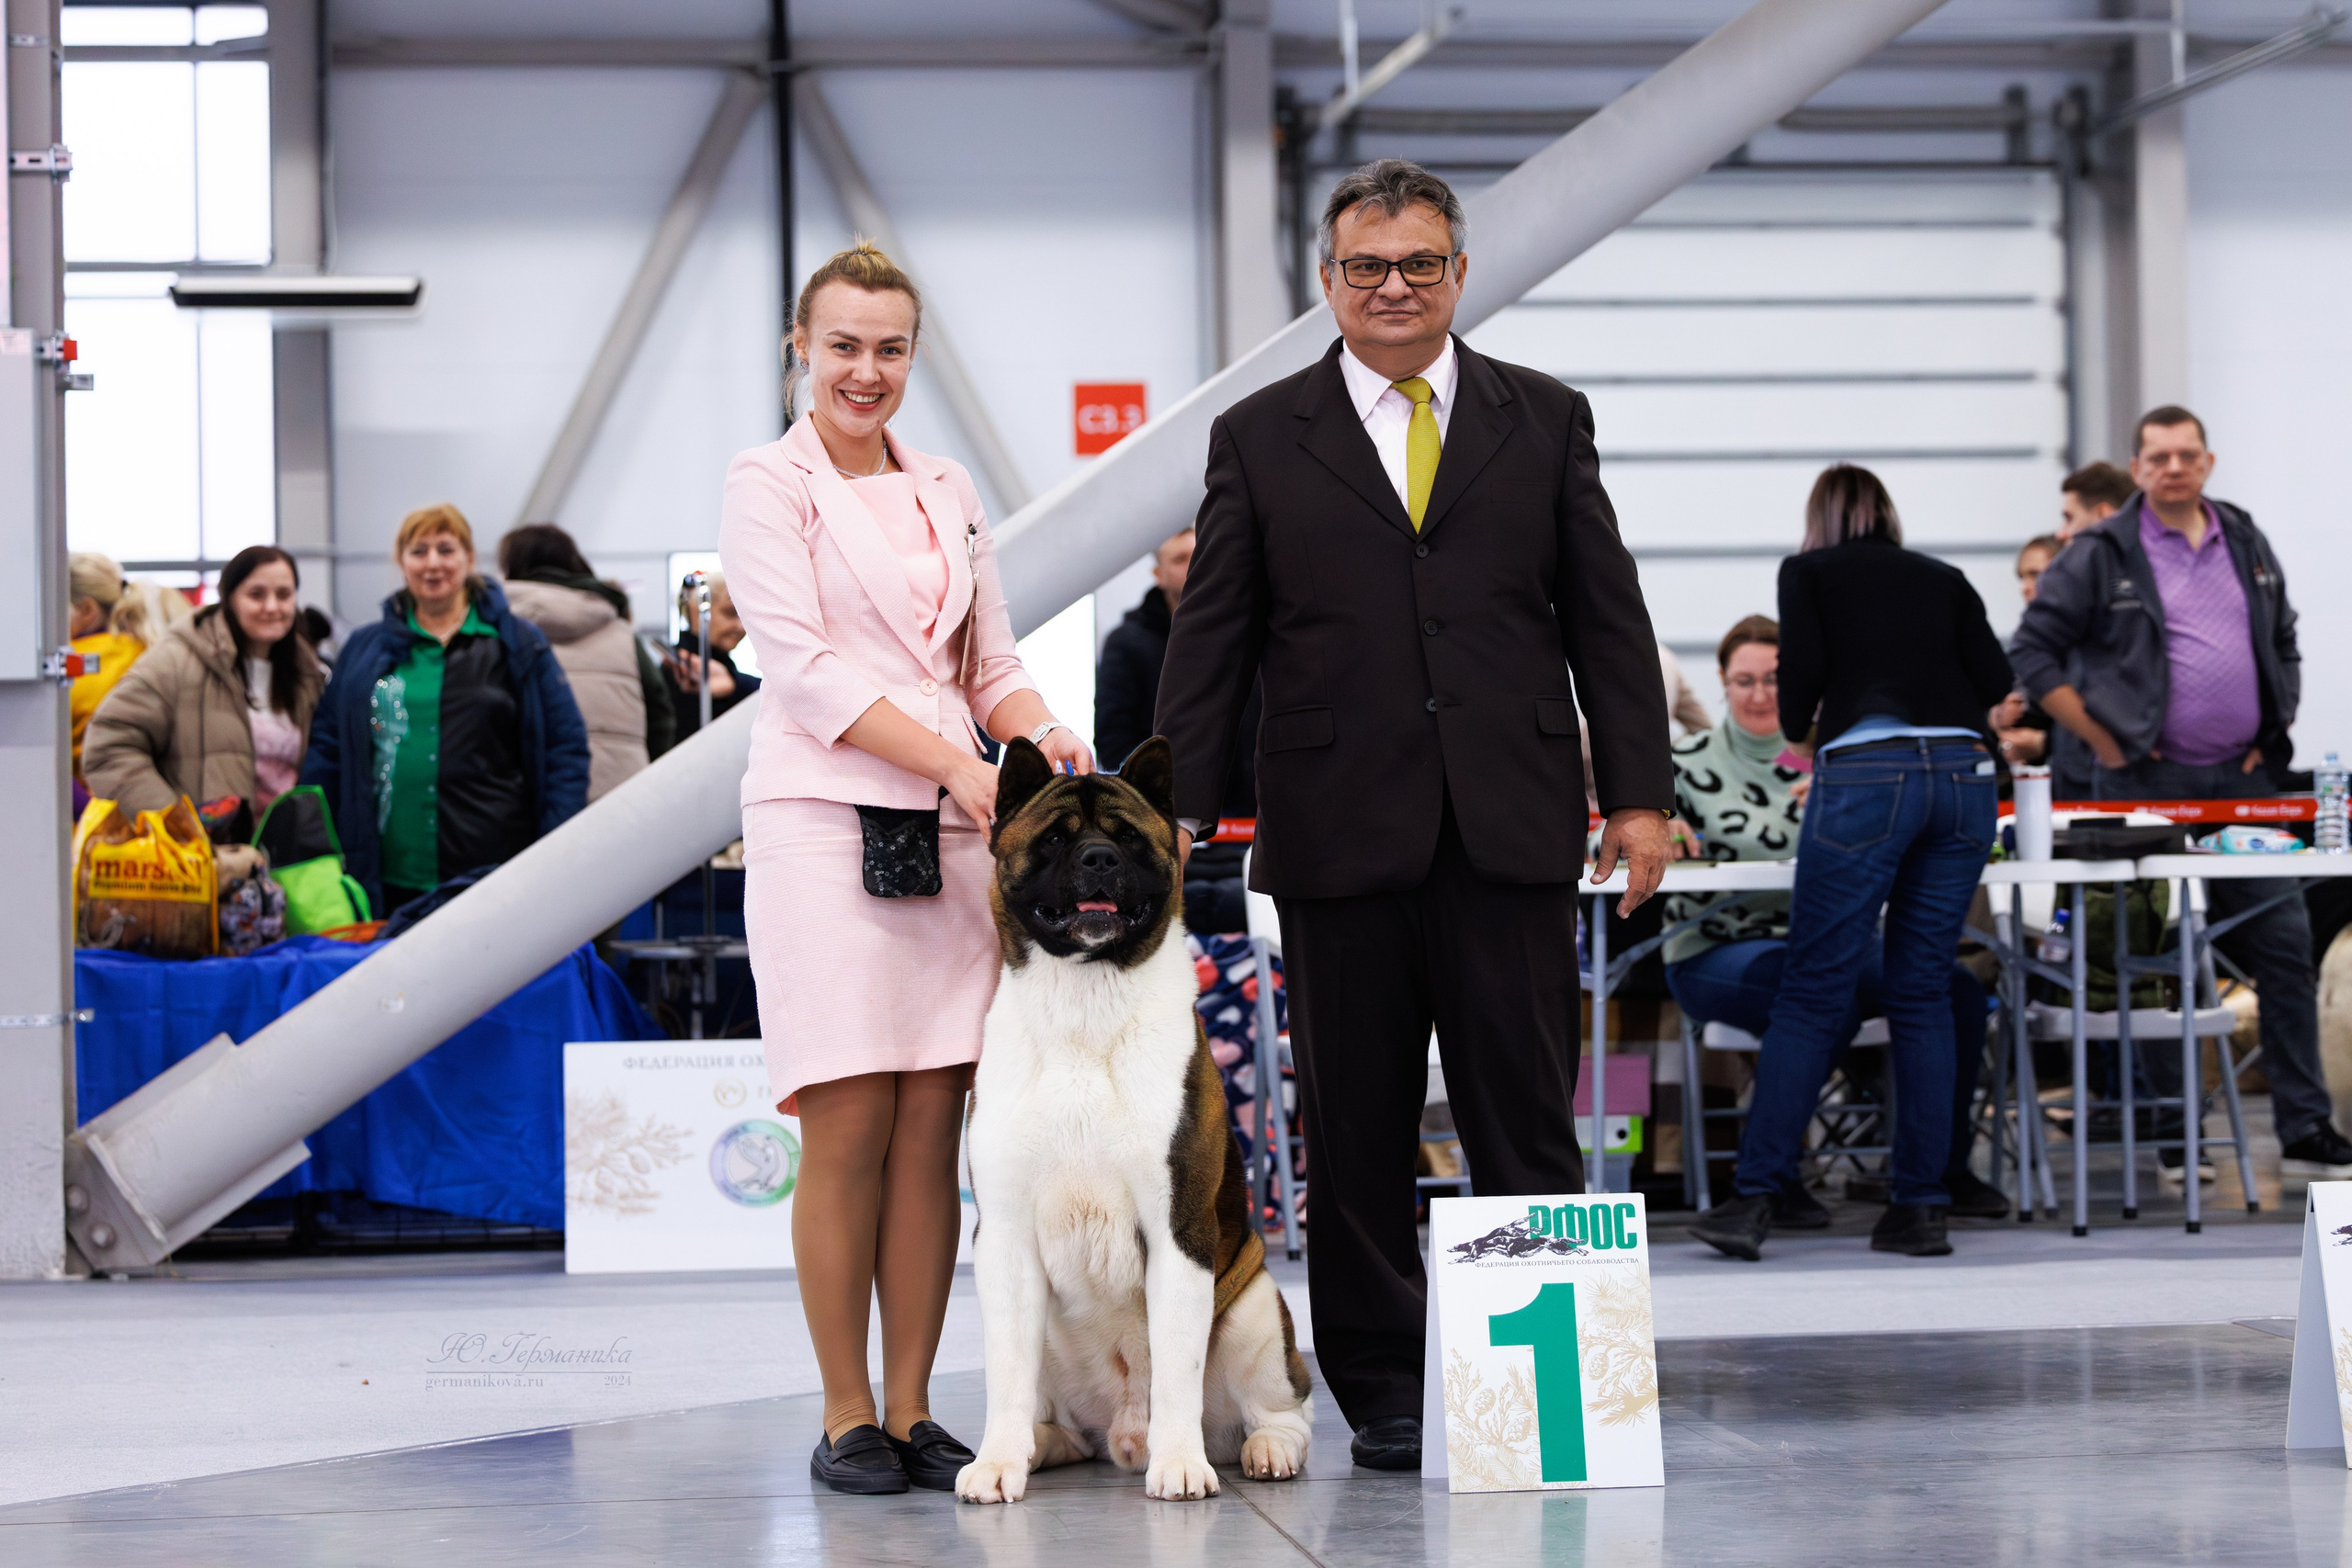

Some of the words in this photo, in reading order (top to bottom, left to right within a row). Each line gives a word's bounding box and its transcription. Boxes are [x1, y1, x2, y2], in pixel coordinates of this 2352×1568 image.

[622, 1055, 734, 1070] ФЕДЕРАЦИЯ
[1528, 1202, 1638, 1250] РФОС
[1576, 1258, 1640, 1266] СОБАКОВОДСТВА
[1488, 1282, 1588, 1483] 1
